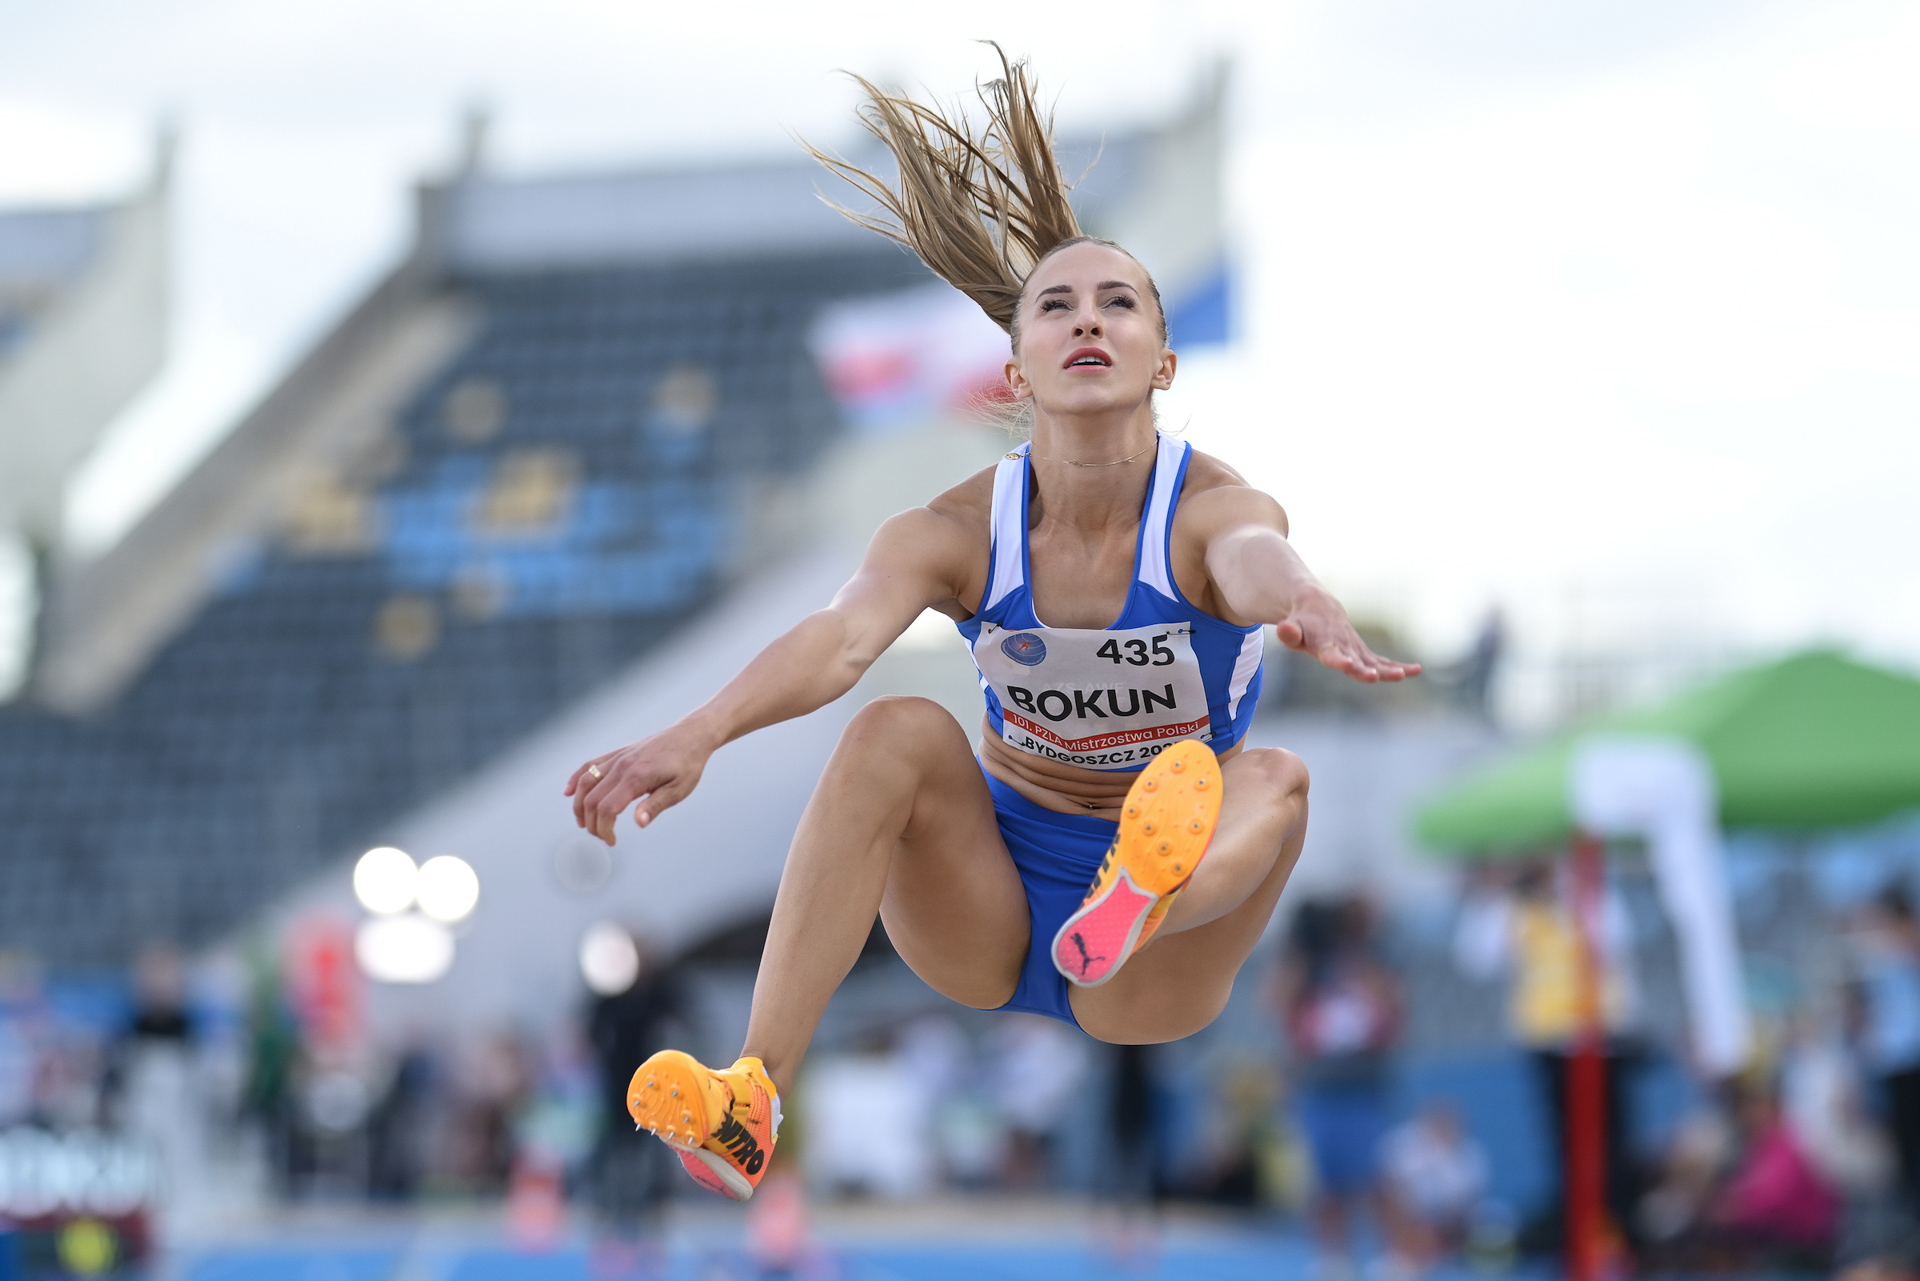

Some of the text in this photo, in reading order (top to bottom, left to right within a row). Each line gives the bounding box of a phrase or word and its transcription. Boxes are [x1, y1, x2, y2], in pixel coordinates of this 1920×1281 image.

[1096, 634, 1175, 667] 435
[1007, 683, 1177, 722] BOKUN
[1012, 713, 1200, 751] 101. PZLA Mistrzostwa Polski
[1025, 736, 1184, 765] BYDGOSZCZ 20
[711, 1110, 765, 1175] NITRO
